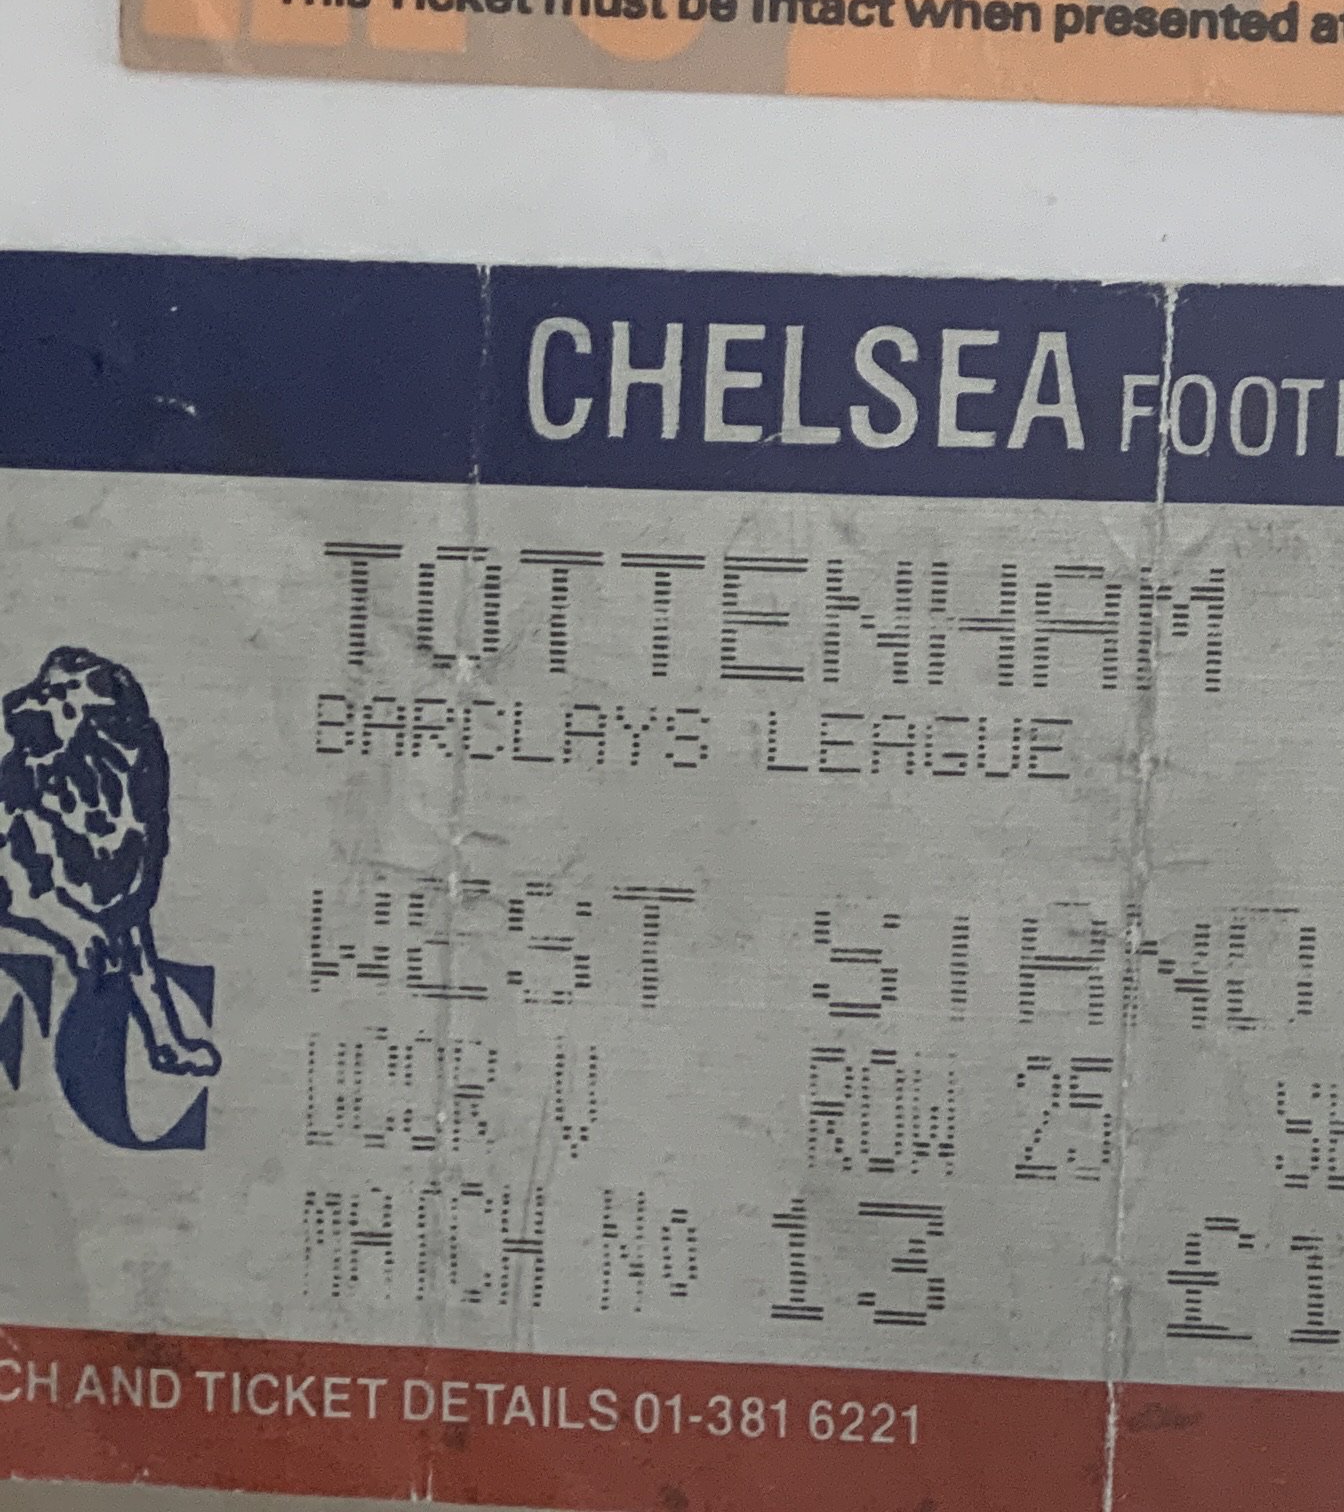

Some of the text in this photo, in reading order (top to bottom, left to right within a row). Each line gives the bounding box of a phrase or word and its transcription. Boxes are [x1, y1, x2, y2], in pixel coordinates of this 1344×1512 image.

[1053, 0, 1298, 44] presented
[527, 317, 1086, 454] CHELSEA
[323, 541, 1226, 692] TOTTENHAM
[317, 694, 1073, 780] BARCLAYS LEAGUE
[809, 1046, 957, 1175] ROW
[74, 1364, 922, 1446] AND TICKET DETAILS 01-381 6221
